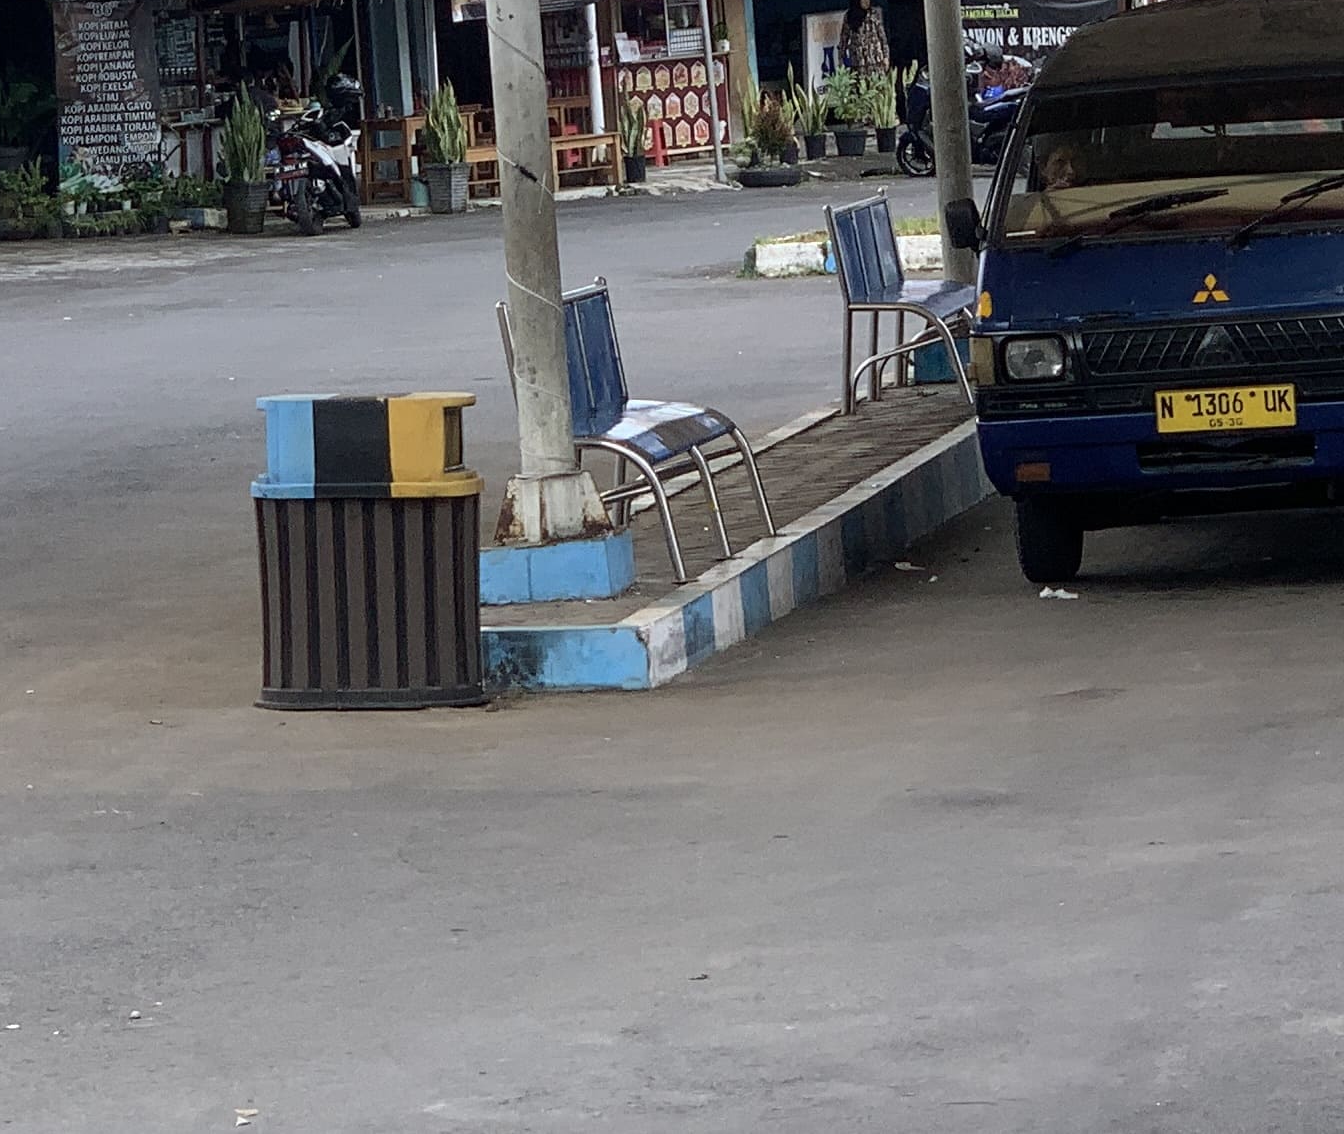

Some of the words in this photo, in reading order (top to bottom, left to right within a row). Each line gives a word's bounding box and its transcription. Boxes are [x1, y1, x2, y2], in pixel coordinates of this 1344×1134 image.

[78, 22, 98, 31] KOPI
[78, 32, 99, 41] KOPI
[1008, 27, 1019, 46] &
[80, 41, 101, 51] KOPI
[76, 53, 98, 62] KOPI
[77, 64, 98, 72] KOPI
[76, 73, 97, 83] KOPI
[80, 84, 101, 93] KOPI
[64, 105, 85, 114] KOPI
[87, 103, 125, 113] ARABIKA
[126, 101, 152, 111] GAYO
[61, 115, 83, 124] KOPI
[84, 113, 123, 123] ARABIKA
[124, 111, 156, 121] TIMTIM
[61, 126, 82, 135] KOPI
[84, 124, 122, 133] ARABIKA
[124, 122, 157, 131] TORAJA
[62, 136, 84, 145] KOPI
[85, 134, 117, 144] EMPON
[1160, 395, 1174, 419] N
[1191, 392, 1244, 417] 1306
[1264, 389, 1292, 413] UK
